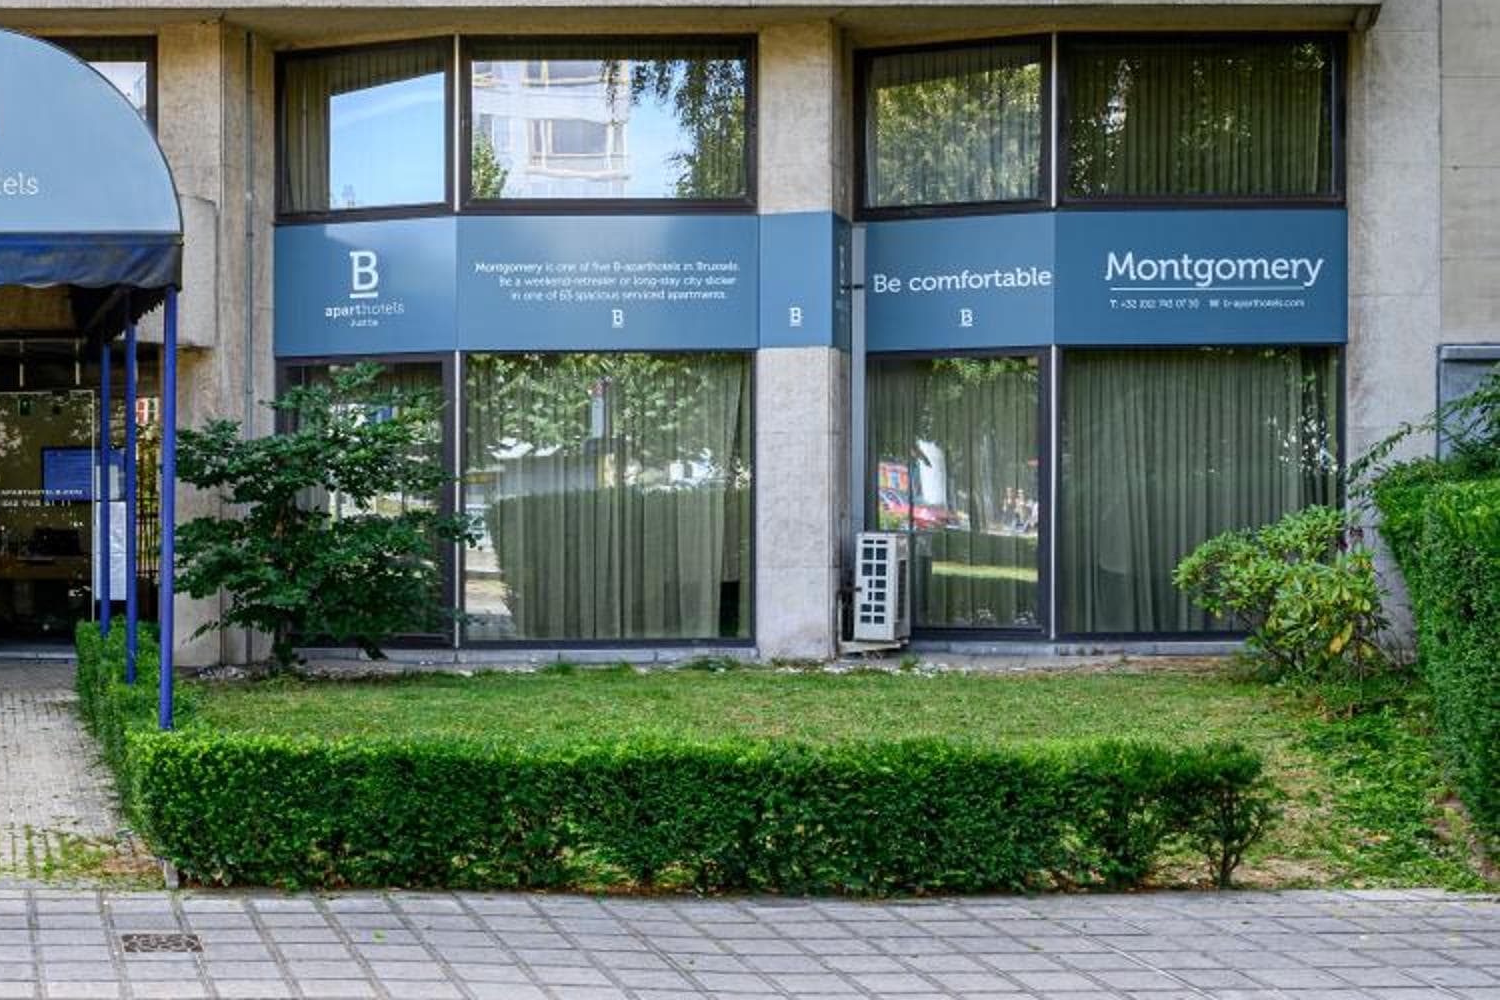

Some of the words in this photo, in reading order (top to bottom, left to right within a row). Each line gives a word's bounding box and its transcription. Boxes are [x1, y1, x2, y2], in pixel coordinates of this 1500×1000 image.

[349, 251, 379, 290] B
[1105, 251, 1323, 287] Montgomery
[873, 273, 900, 293] Be
[908, 267, 1053, 291] comfortable
[325, 301, 404, 319] aparthotels
[612, 309, 624, 325] B
[789, 307, 801, 323] B
[961, 308, 973, 324] B
